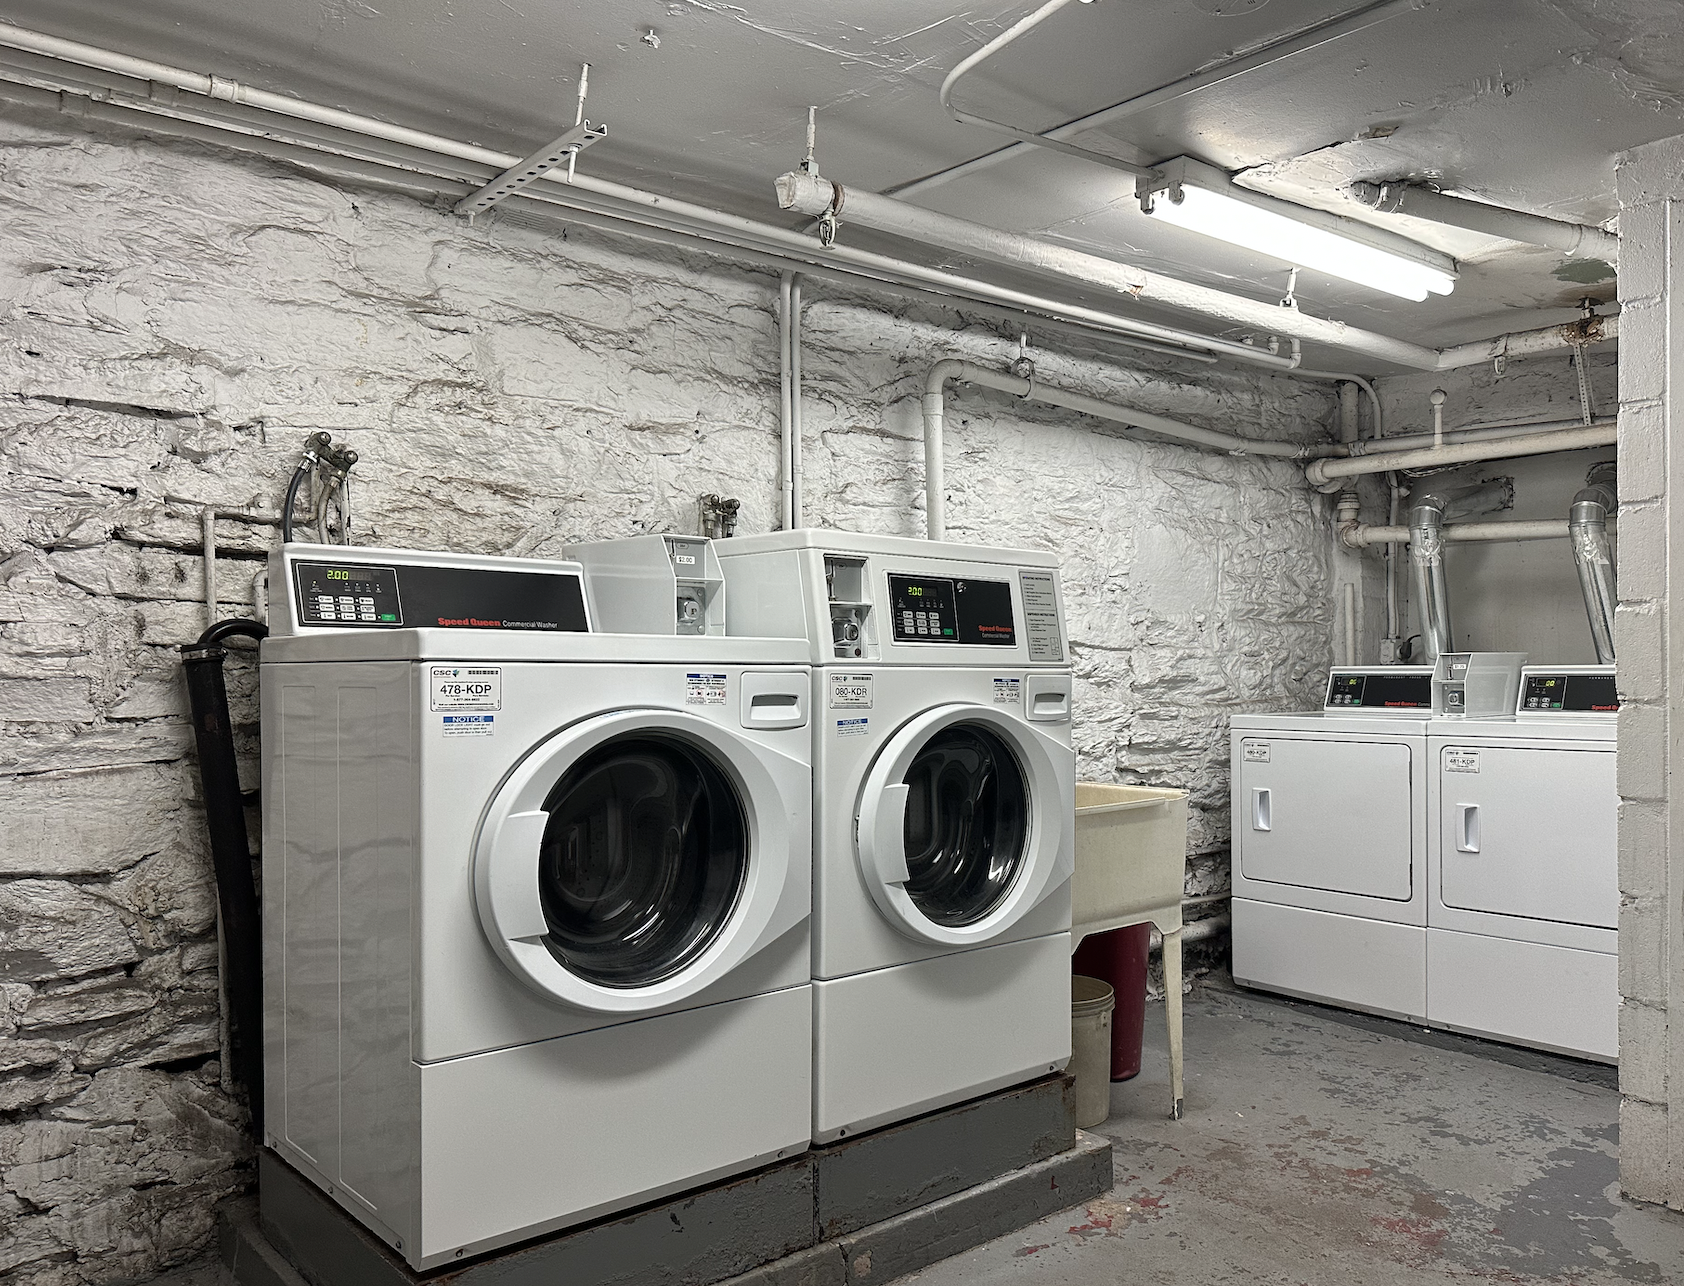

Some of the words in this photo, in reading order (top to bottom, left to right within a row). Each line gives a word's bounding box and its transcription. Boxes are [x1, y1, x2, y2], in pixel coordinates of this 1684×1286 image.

[326, 570, 349, 580] 2.00
[438, 617, 468, 626] Speed
[470, 618, 500, 626] Queen
[440, 684, 492, 694] 478-KDP
[835, 687, 867, 695] 080-KDR
